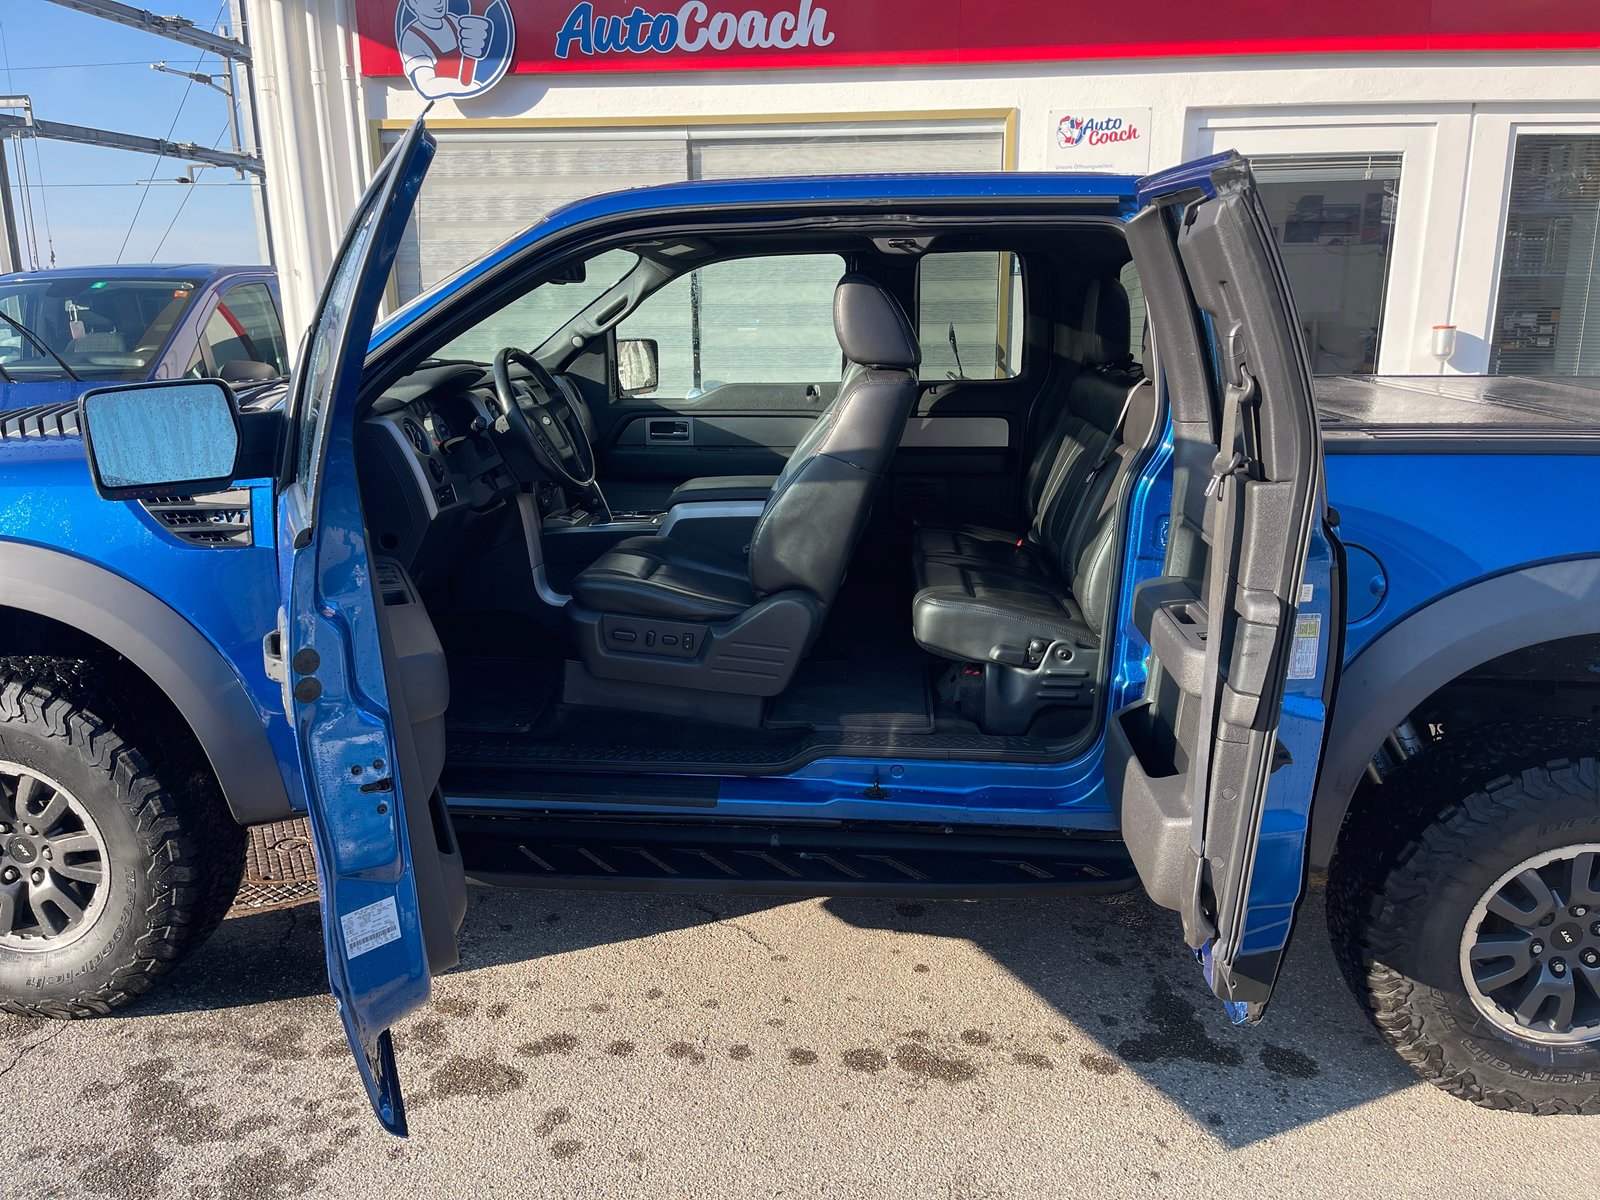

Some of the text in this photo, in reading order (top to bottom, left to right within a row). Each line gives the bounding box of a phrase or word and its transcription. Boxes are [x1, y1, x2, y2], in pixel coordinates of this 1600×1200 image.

[555, 0, 835, 58] AutoCoach
[1083, 117, 1122, 134] Auto
[1088, 124, 1140, 146] Coach
[213, 510, 249, 523] SVT
[1560, 930, 1573, 943] SVT
